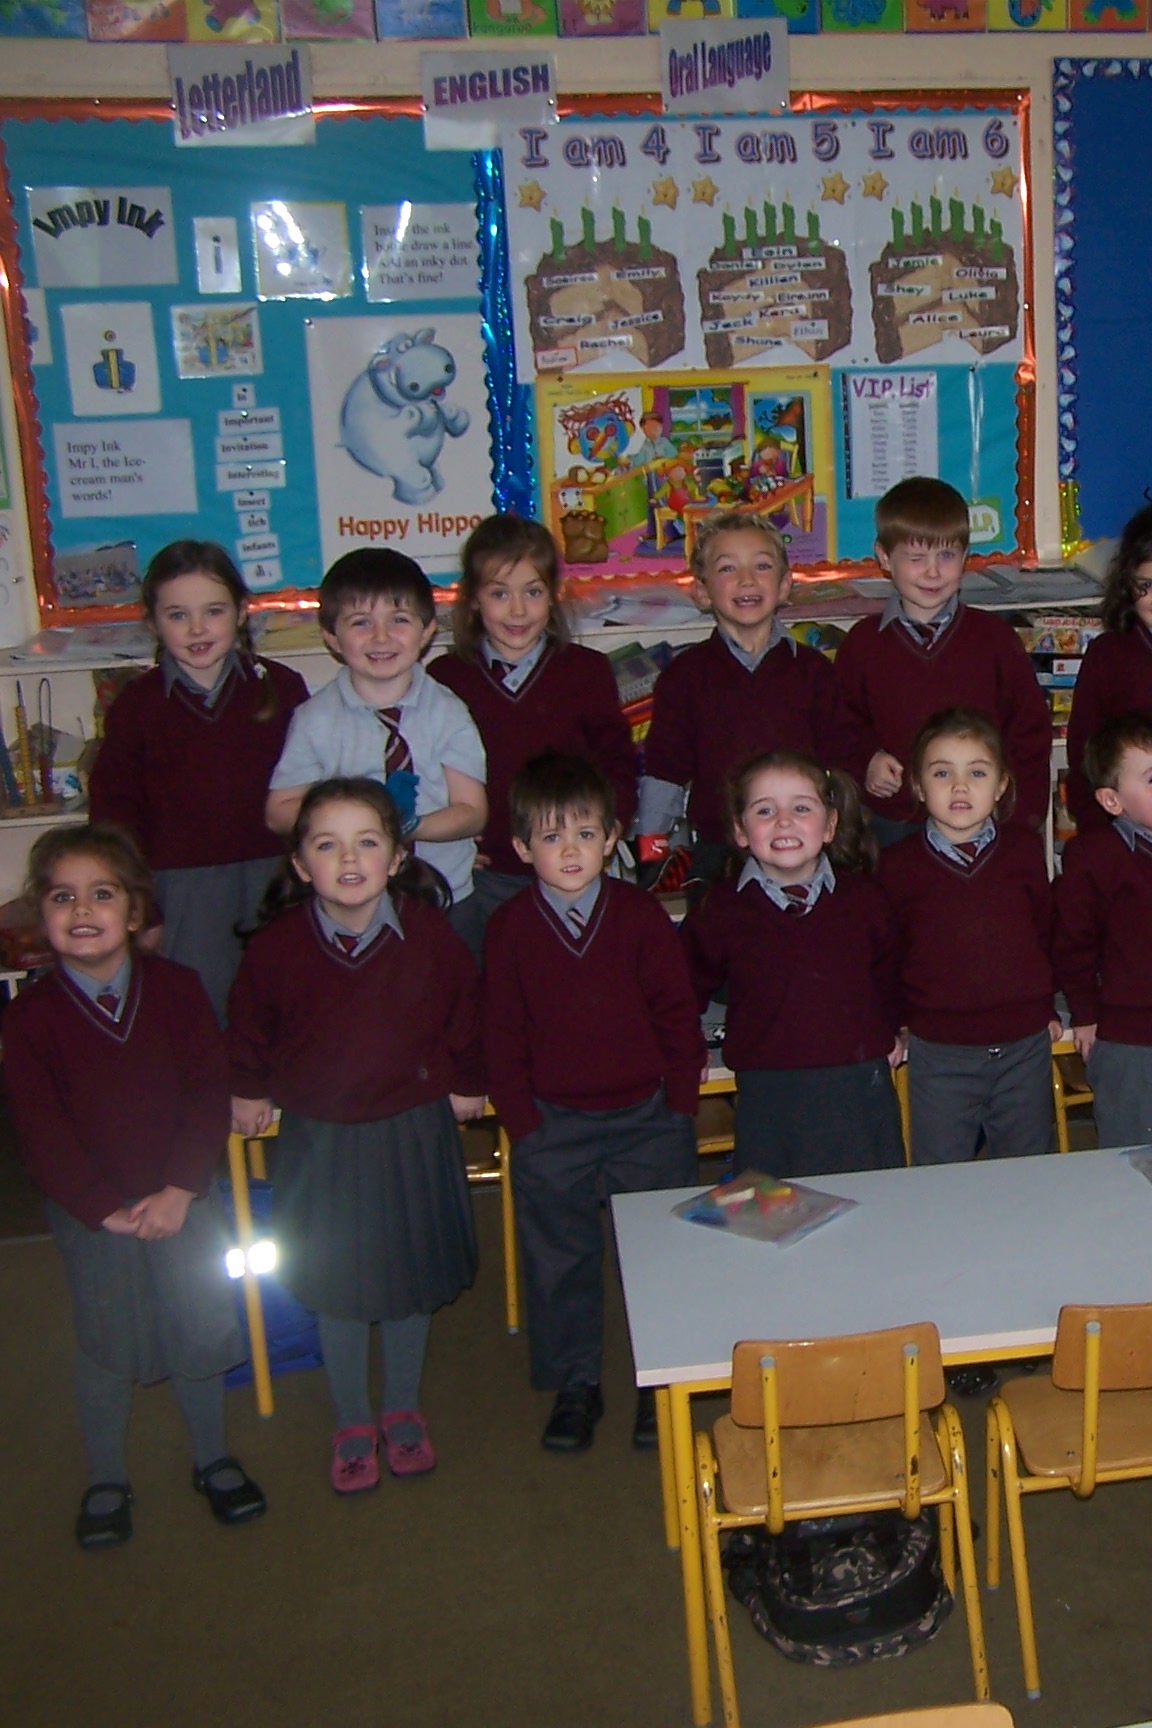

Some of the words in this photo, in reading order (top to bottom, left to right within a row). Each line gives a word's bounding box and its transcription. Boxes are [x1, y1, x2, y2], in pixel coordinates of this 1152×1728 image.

[669, 40, 698, 98] Oral
[700, 31, 772, 89] Language
[433, 63, 550, 107] ENGLISH
[520, 127, 549, 168] I
[563, 135, 627, 168] am
[640, 123, 671, 165] 4
[693, 123, 721, 165] I
[736, 129, 798, 164] am
[812, 119, 840, 162] 5
[867, 119, 895, 160] I
[909, 126, 969, 160] am
[982, 117, 1010, 160] 6
[33, 199, 110, 239] Impy
[118, 196, 165, 239] Ink
[412, 224, 430, 235] the
[432, 223, 451, 234] ink
[411, 241, 438, 250] draw
[212, 235, 223, 274] i
[380, 273, 415, 284] That's
[418, 271, 443, 284] fine!
[616, 269, 660, 280] Emily
[955, 268, 998, 279] Olivia
[749, 275, 798, 287] Killian
[949, 290, 988, 301] Luke
[542, 315, 594, 326] Craig
[709, 318, 753, 330] Jack
[912, 313, 959, 324] Alice
[900, 375, 932, 398] List
[67, 441, 98, 455] Impy
[102, 440, 121, 452] Ink
[69, 458, 87, 470] Mr
[102, 456, 121, 468] the
[70, 475, 107, 486] cream
[109, 472, 144, 485] man's
[72, 489, 112, 502] words!
[338, 515, 410, 541] Happy
[417, 512, 483, 538] Hippo
